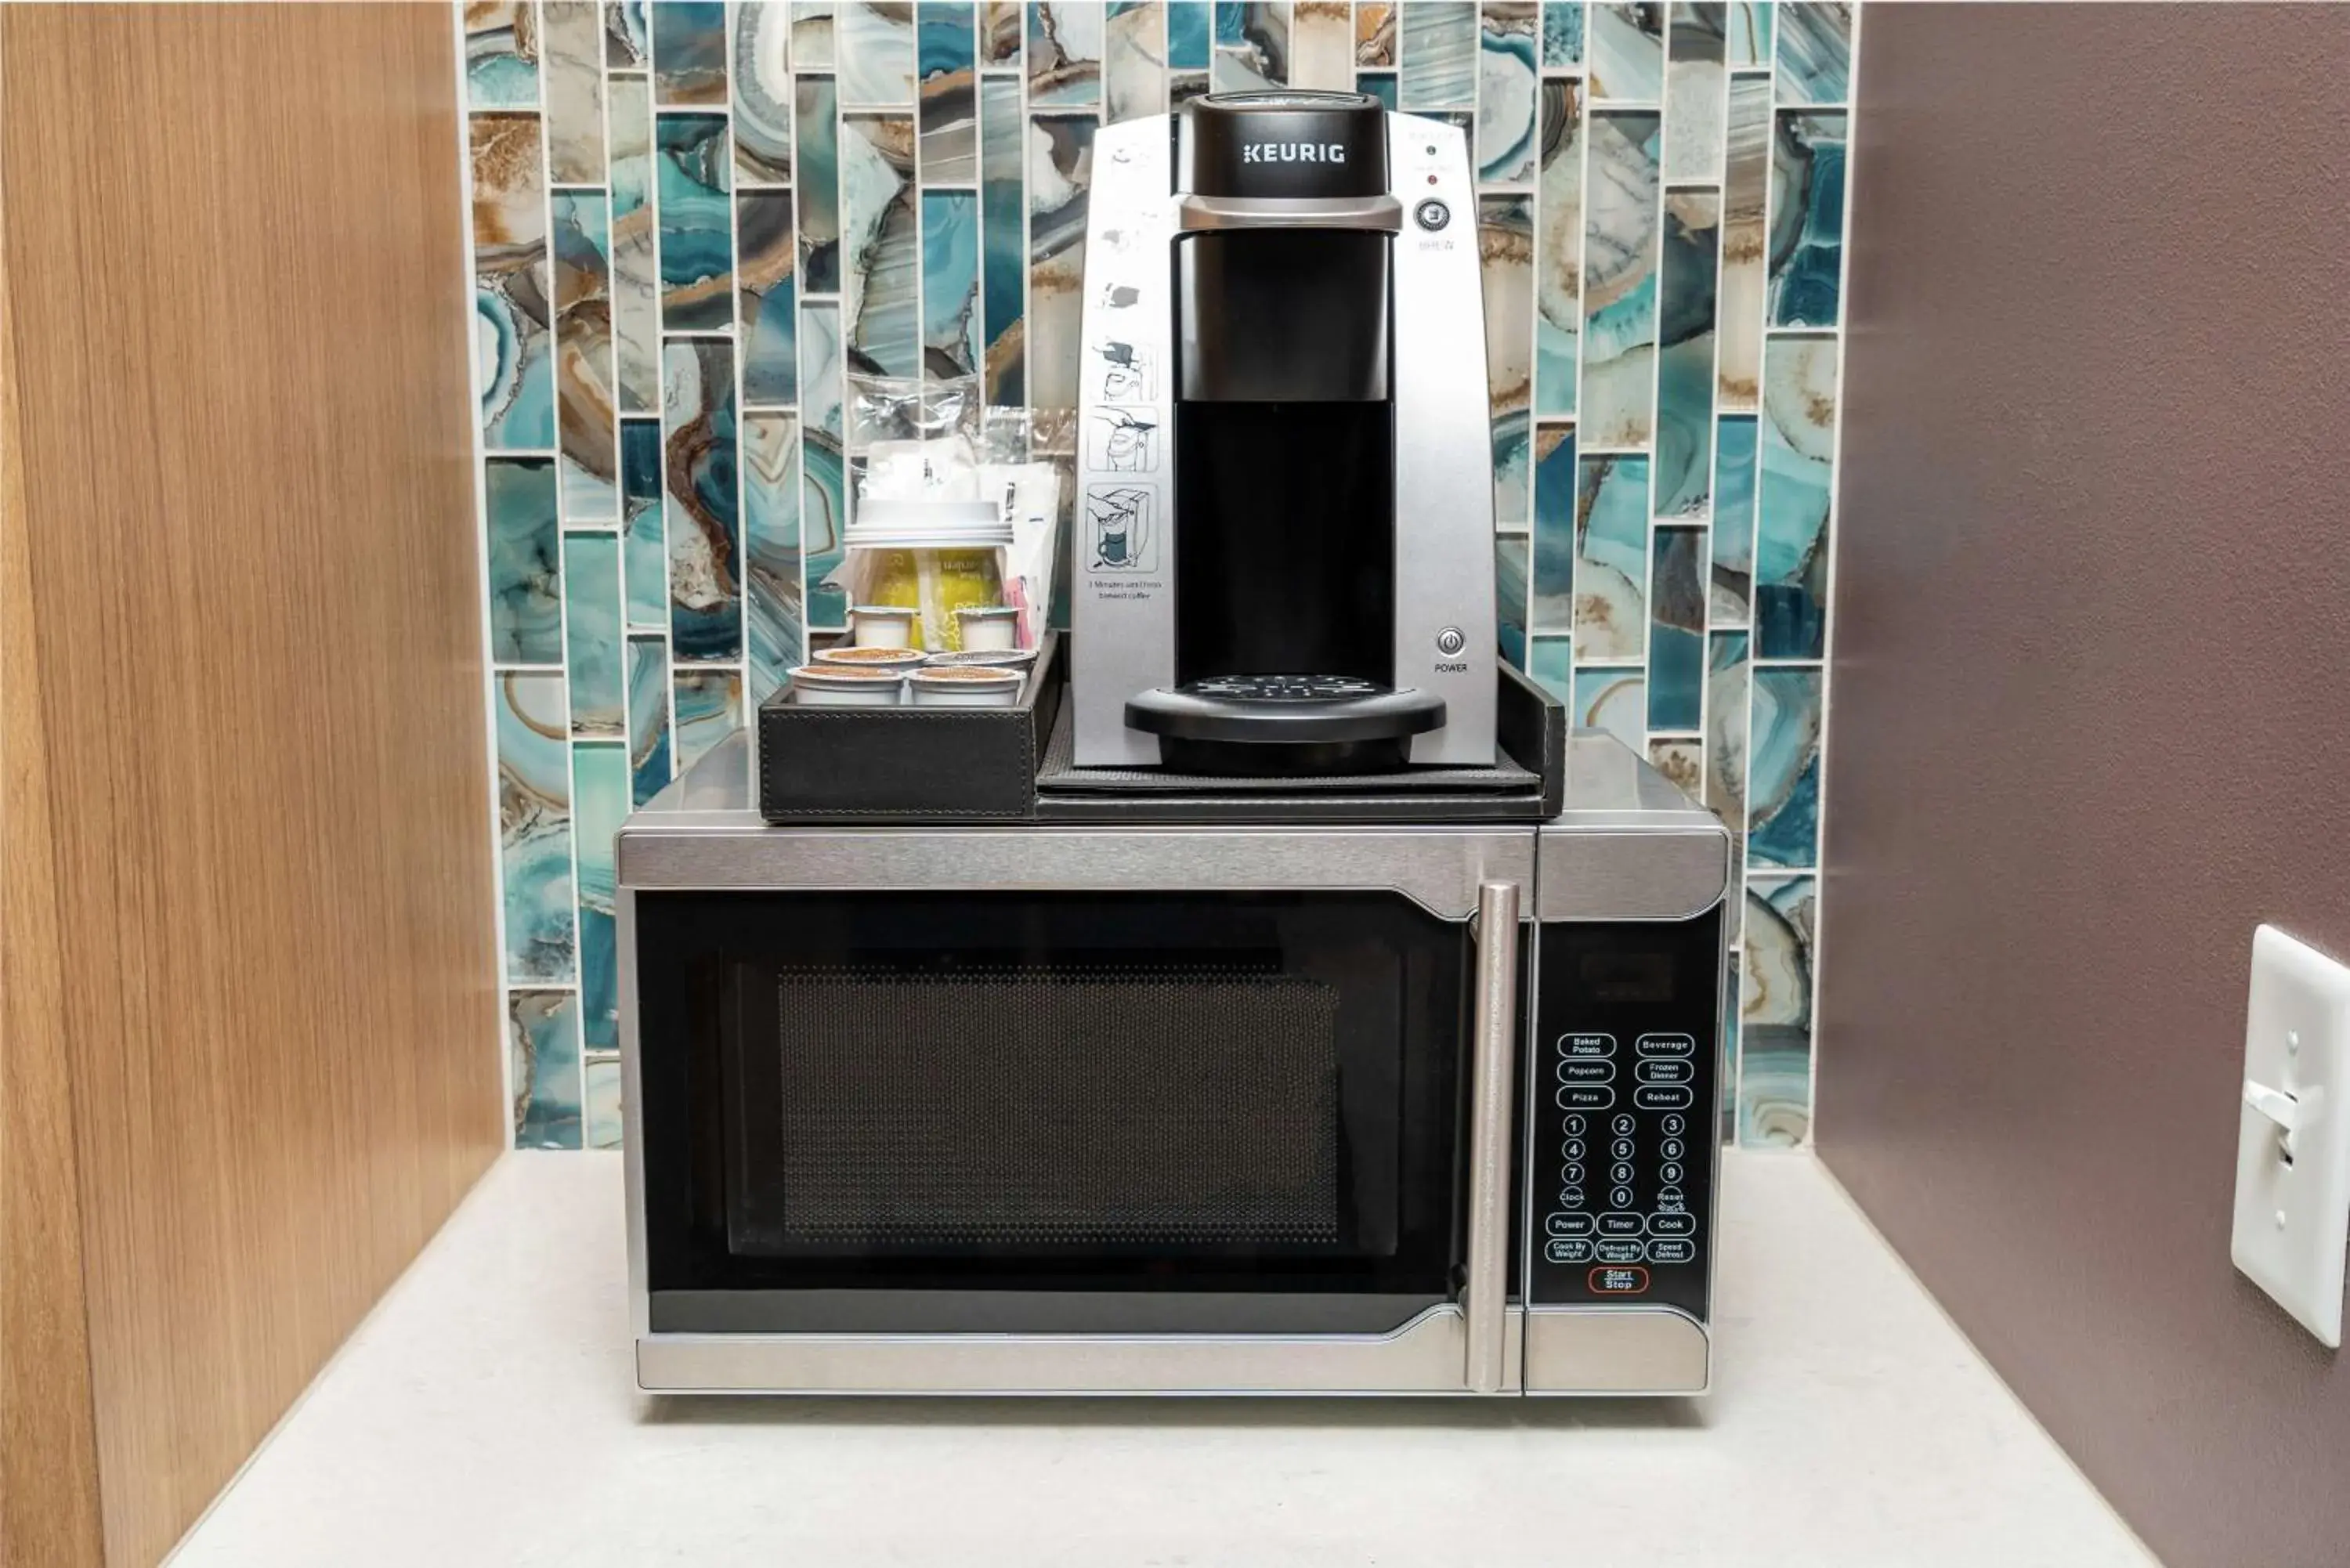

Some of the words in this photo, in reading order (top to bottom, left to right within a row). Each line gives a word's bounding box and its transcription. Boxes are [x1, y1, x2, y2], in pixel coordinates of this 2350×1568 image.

[1242, 143, 1346, 164] KEURIG
[1434, 663, 1467, 673] POWER
[1643, 1041, 1688, 1050] Beverage
[1568, 1067, 1605, 1075] Popcorn
[1649, 1063, 1679, 1071] Frozen
[1650, 1071, 1679, 1079] Dinner
[1572, 1093, 1599, 1102] Pizza
[1647, 1093, 1680, 1101] Reheat
[1570, 1119, 1577, 1132] 1
[1619, 1119, 1629, 1131] 2
[1669, 1118, 1678, 1131] 3
[1569, 1143, 1578, 1155] 4
[1618, 1143, 1628, 1155] 5
[1668, 1143, 1677, 1155] 6
[1568, 1167, 1578, 1179] 7
[1618, 1167, 1627, 1179] 8
[1667, 1166, 1676, 1179] 9
[1560, 1193, 1585, 1201] Clock
[1617, 1190, 1625, 1202] 0
[1555, 1219, 1585, 1229] Power
[1607, 1219, 1634, 1229] Timer
[1658, 1219, 1683, 1229] Cook
[1574, 1242, 1586, 1252] By
[1657, 1243, 1682, 1252] Speed
[1606, 1270, 1633, 1278] Start
[1605, 1280, 1633, 1290] Stop
